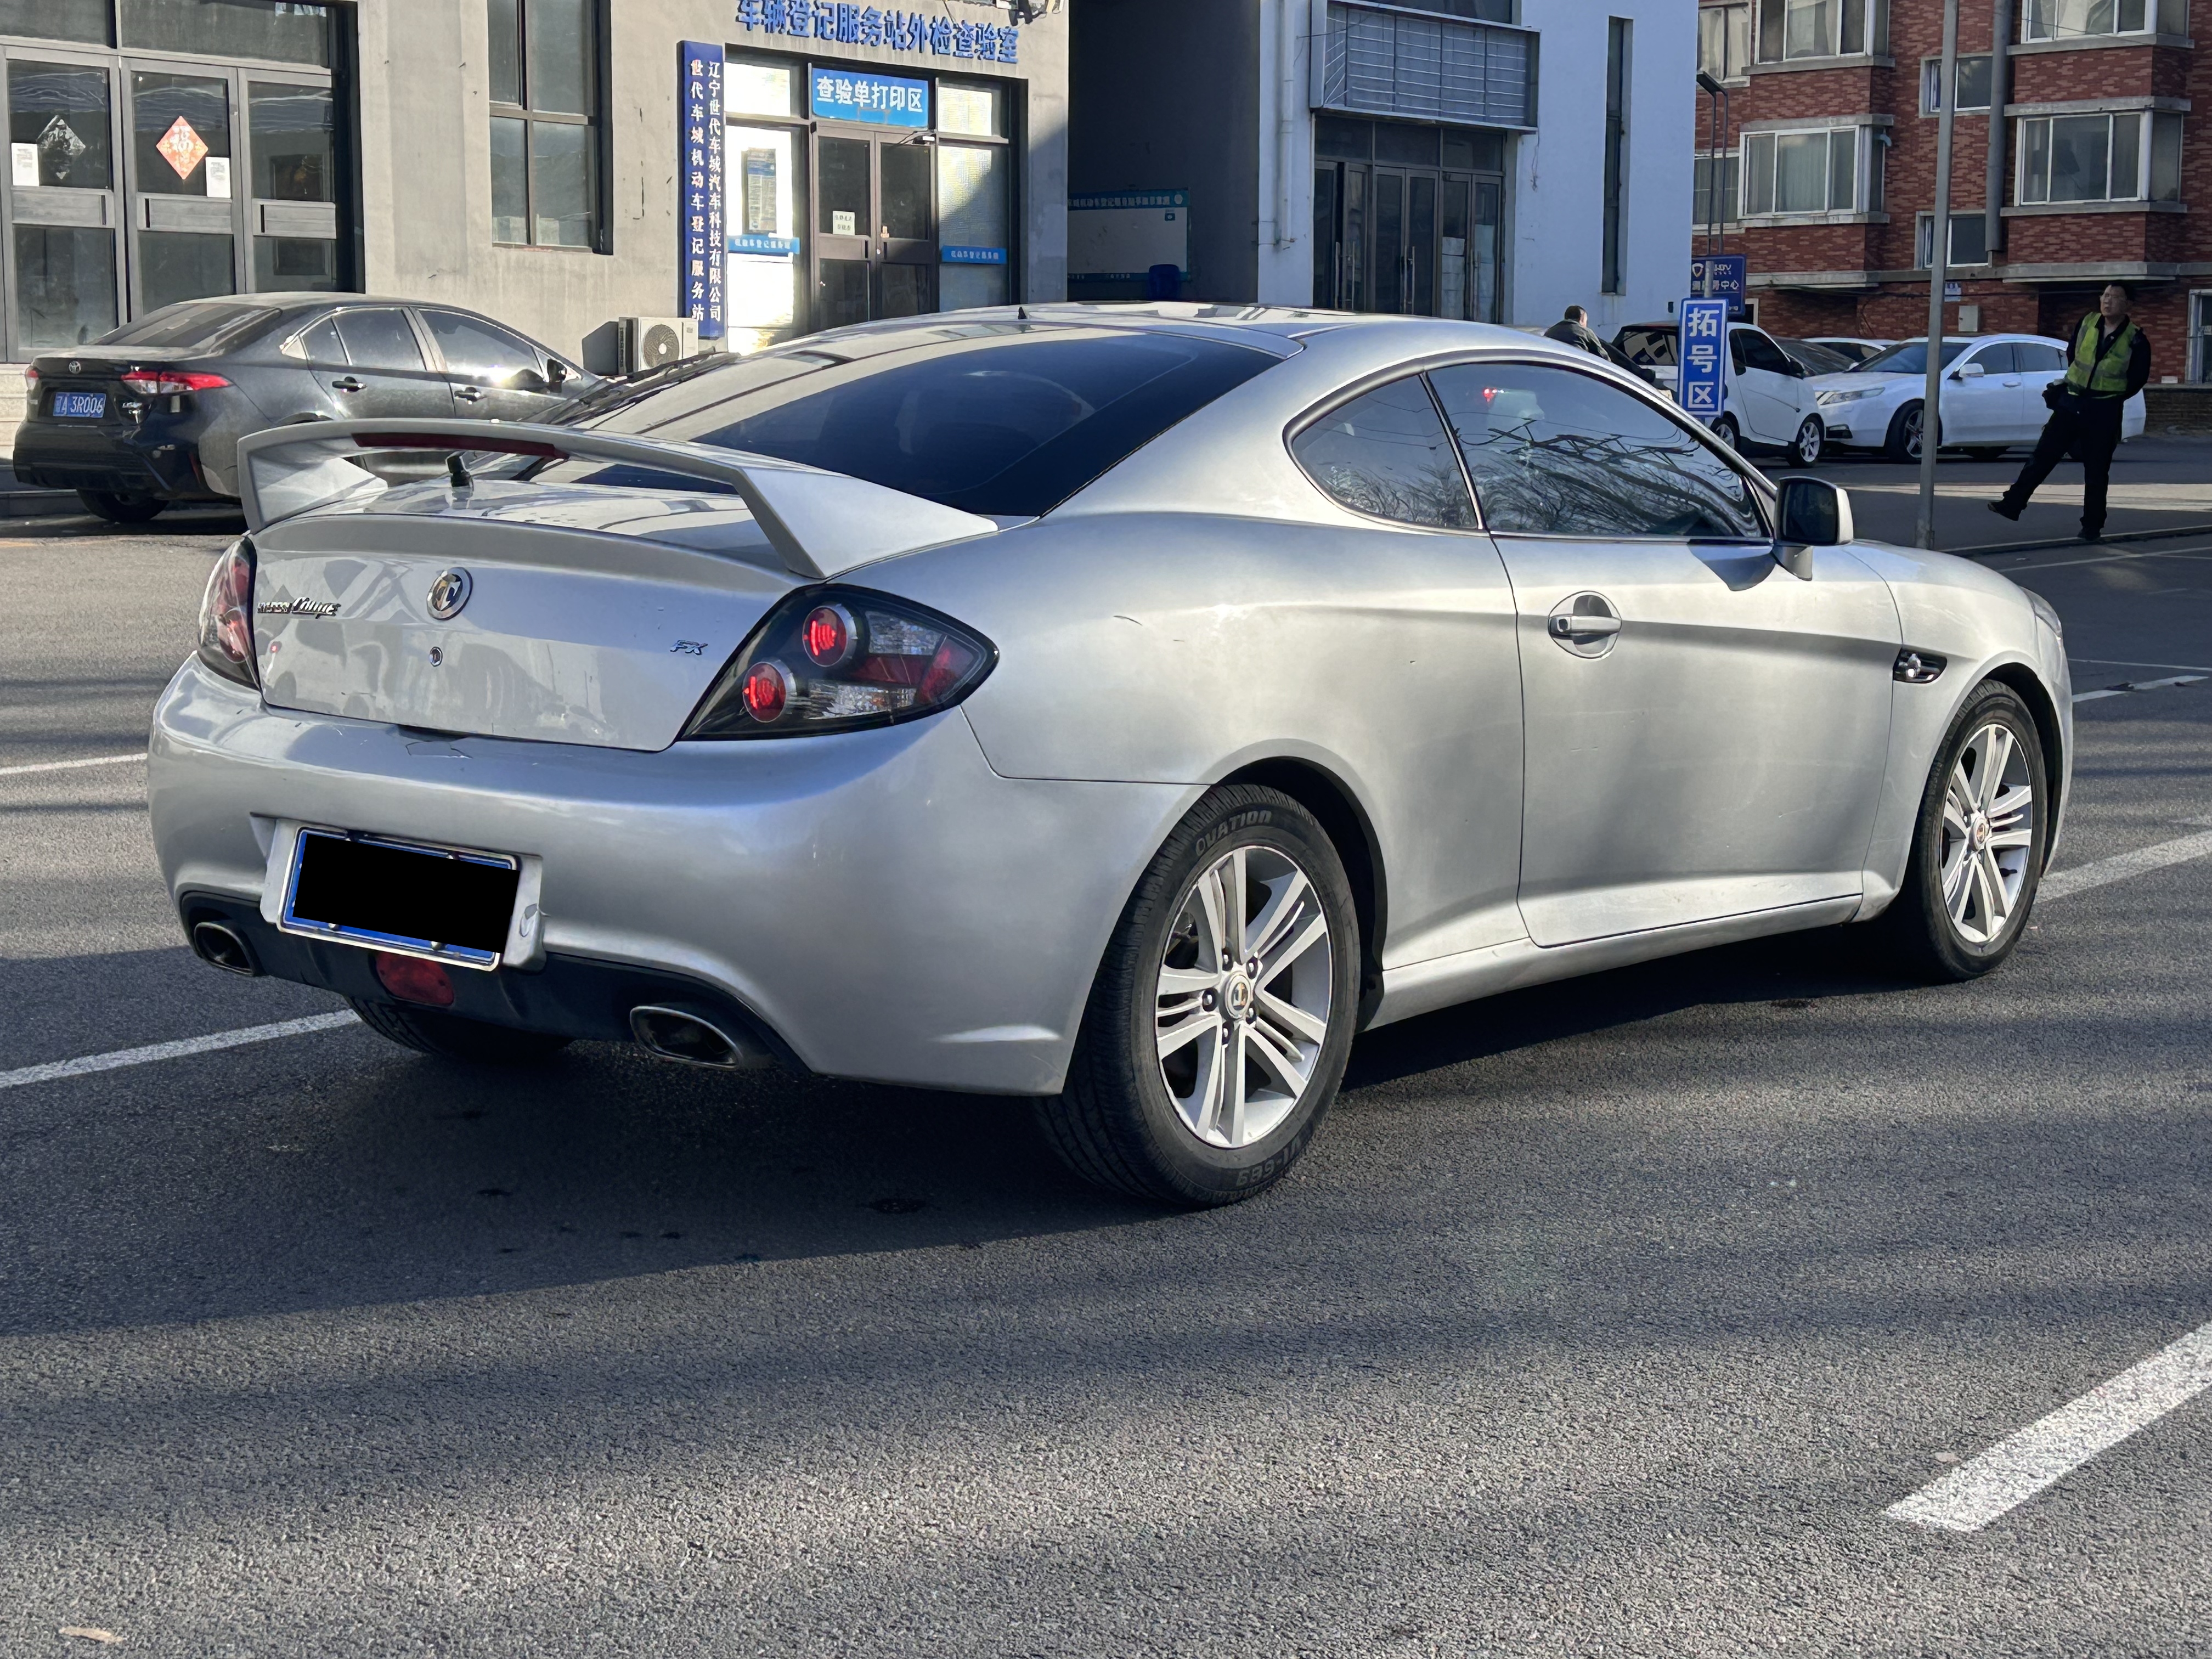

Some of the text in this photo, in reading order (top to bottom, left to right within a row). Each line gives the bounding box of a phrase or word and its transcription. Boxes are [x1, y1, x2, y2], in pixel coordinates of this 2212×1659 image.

[736, 0, 1018, 64] 车辆登记服务站外检查验室
[817, 76, 923, 112] 查验单打印区
[691, 59, 704, 321] 世代车城机动车登记服务站
[708, 61, 721, 322] 辽宁世代车城汽车科技有限公司
[1687, 307, 1719, 409] 拓号区
[1195, 810, 1272, 856] OVATION
